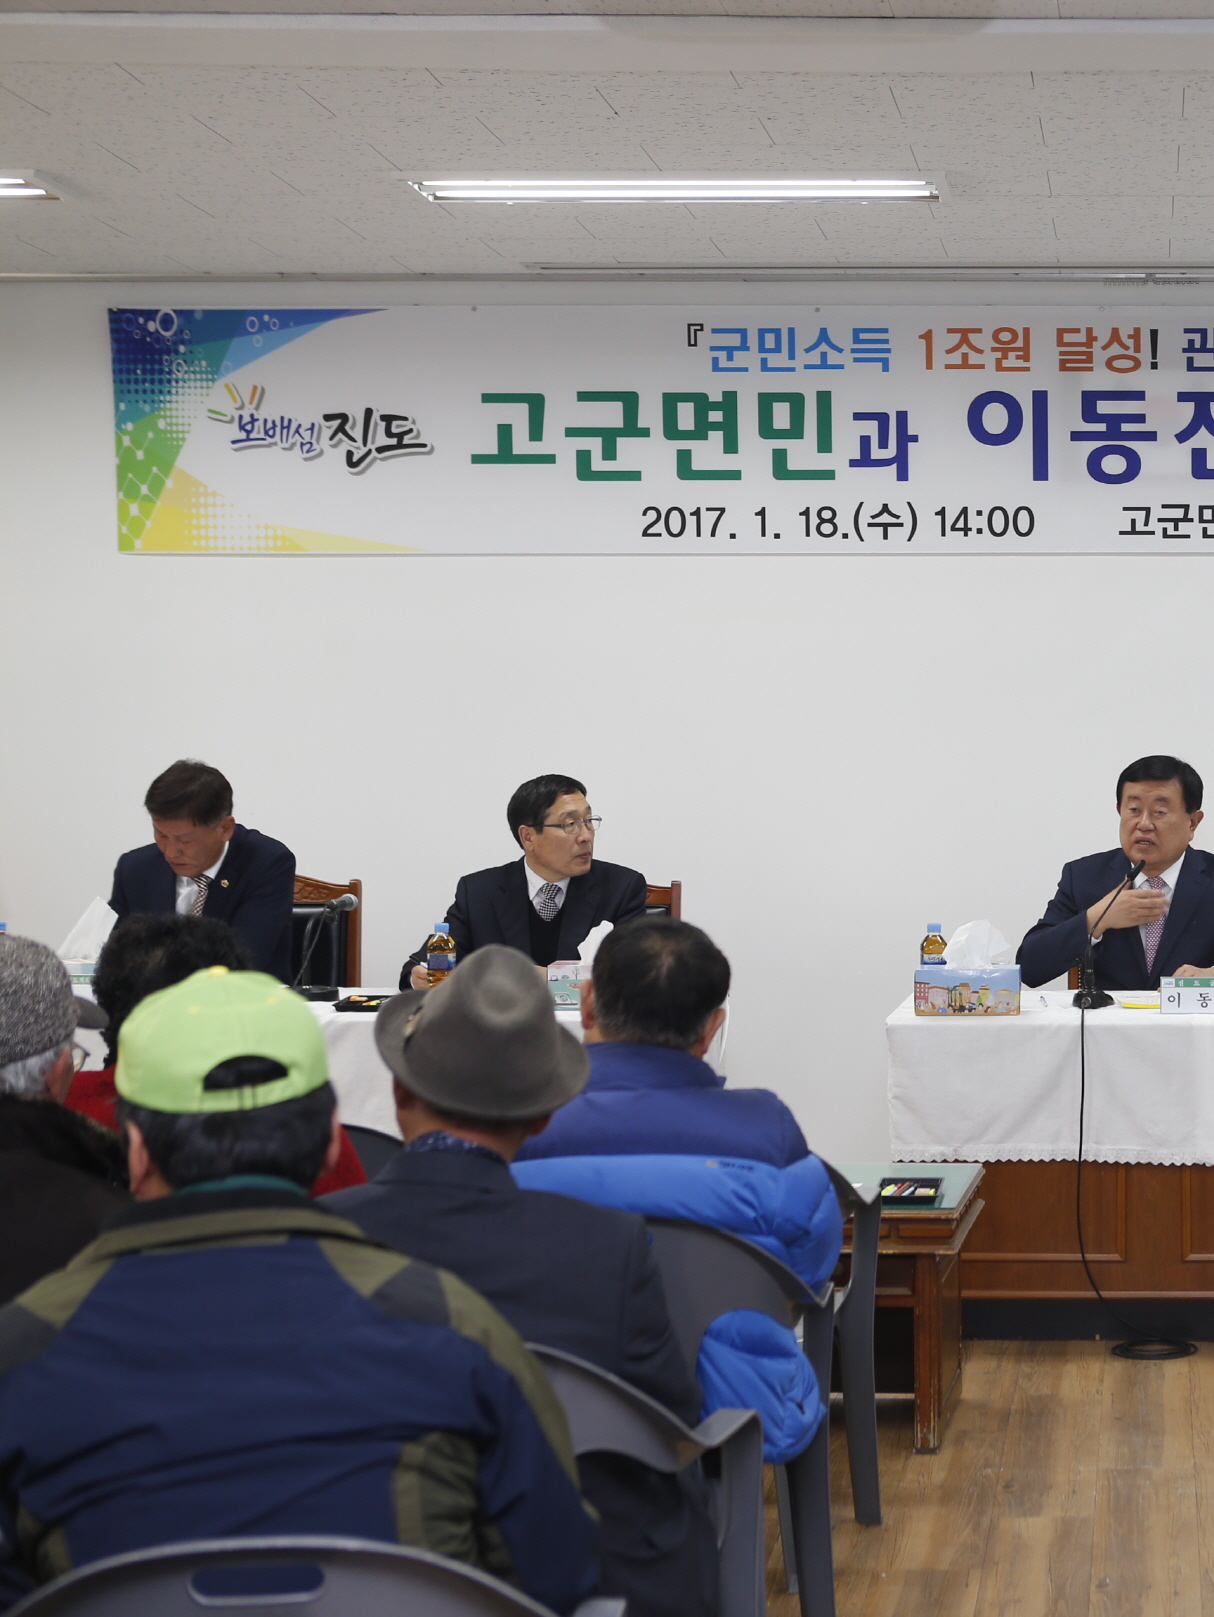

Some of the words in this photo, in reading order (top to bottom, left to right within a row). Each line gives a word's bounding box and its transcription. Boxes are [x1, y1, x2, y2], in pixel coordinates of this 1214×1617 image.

[918, 327, 1031, 372] 1조원
[1056, 326, 1159, 374] 달성!
[230, 412, 318, 454] 보배섬
[322, 407, 428, 469] 진도
[470, 390, 919, 482] 고군면민과
[641, 505, 737, 540] 2017.
[754, 506, 781, 540] 1.
[934, 505, 1035, 539] 14:00
